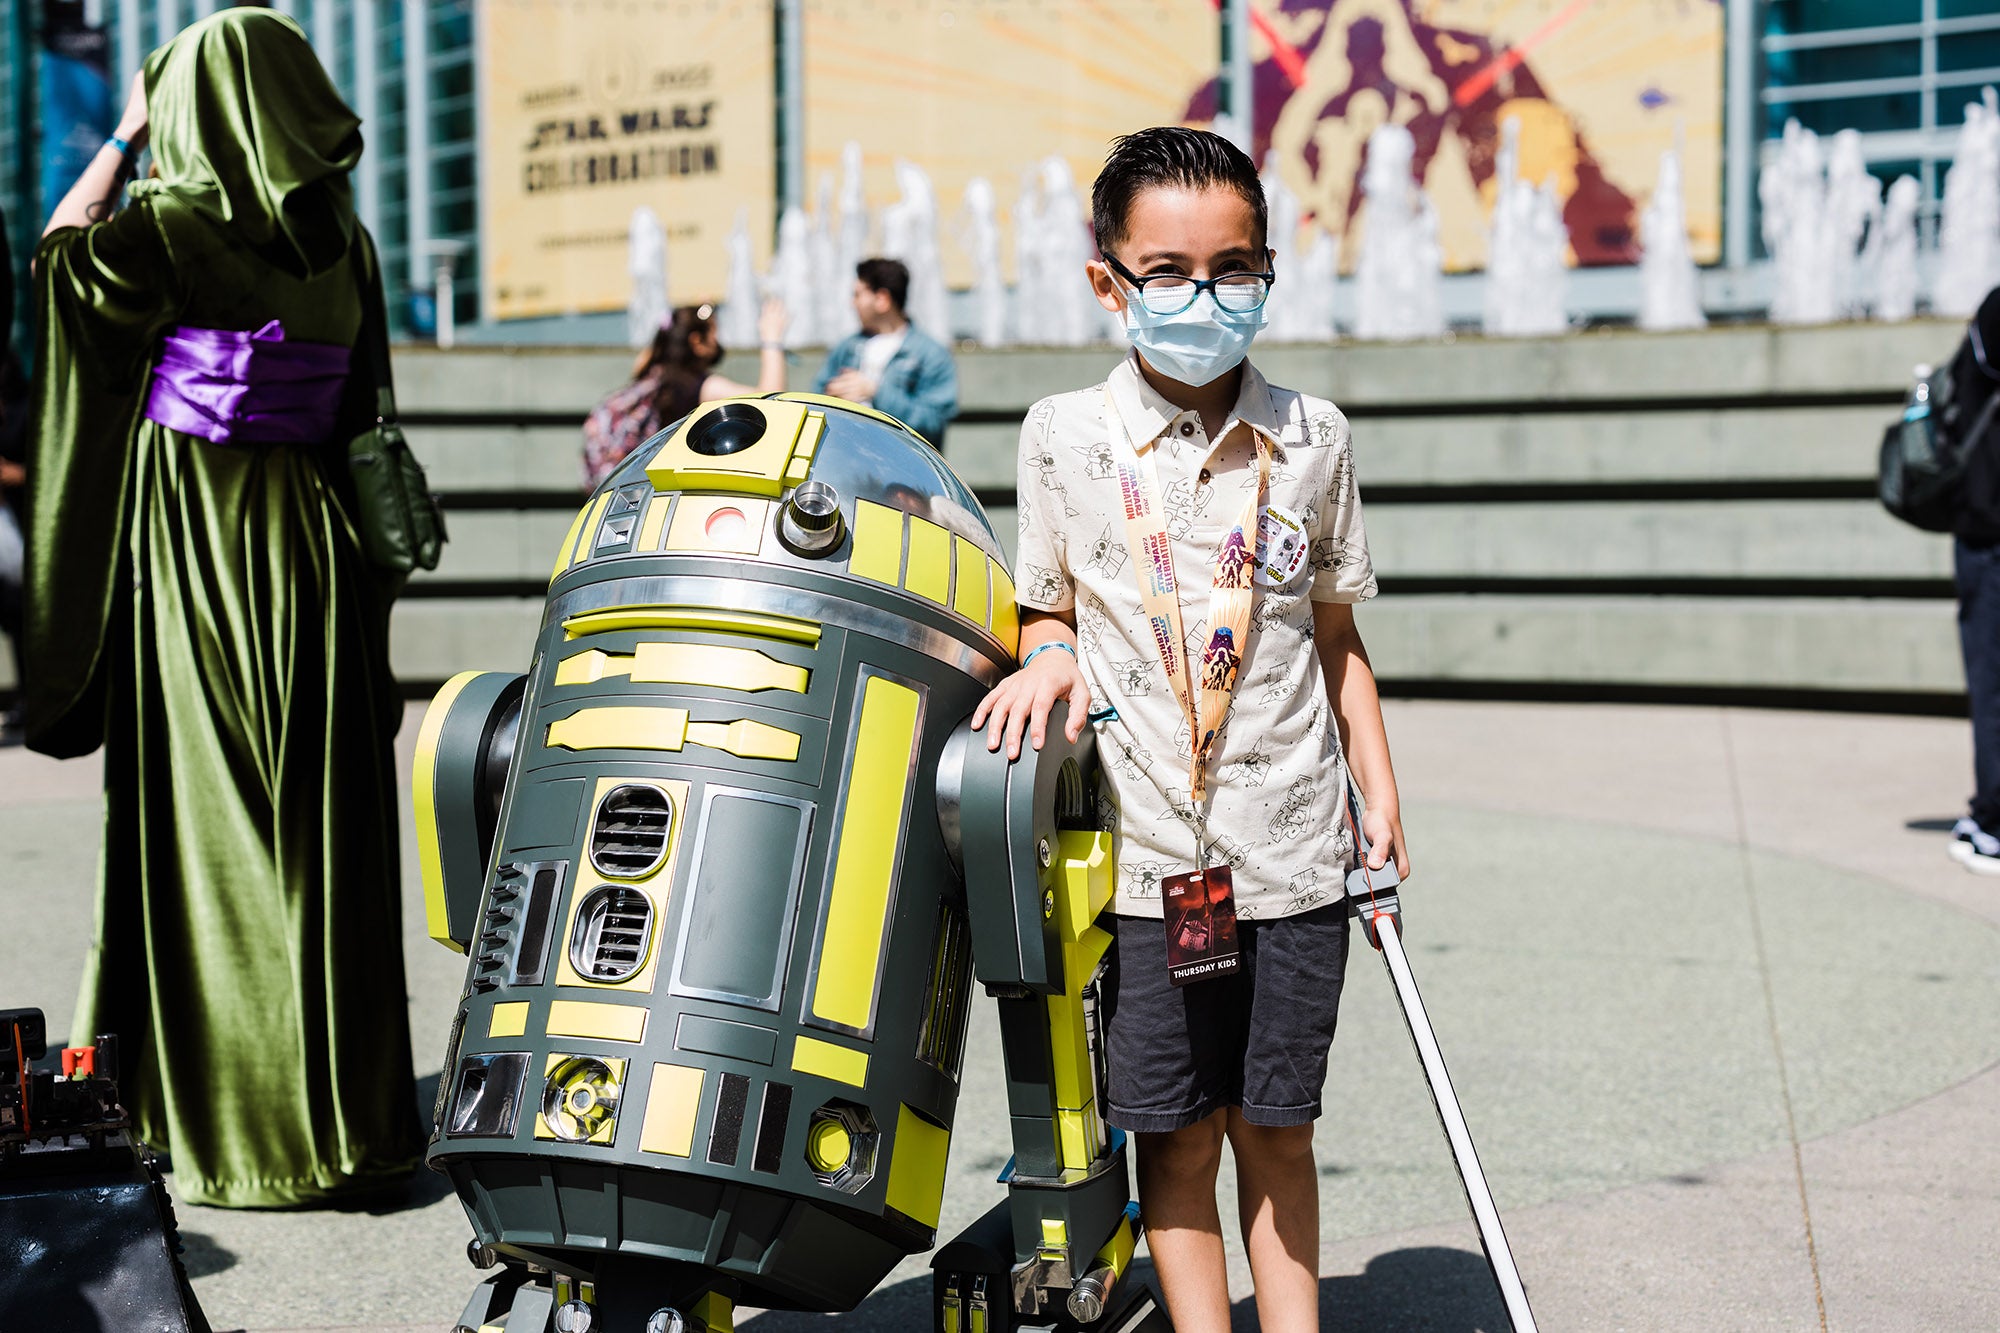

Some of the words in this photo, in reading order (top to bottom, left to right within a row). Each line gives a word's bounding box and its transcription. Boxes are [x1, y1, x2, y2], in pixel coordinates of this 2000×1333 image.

[1118, 463, 1135, 520] CELEBRATION
[1132, 489, 1143, 517] WARS
[1149, 534, 1161, 564] WARS
[1157, 531, 1174, 593] CELEBRATION
[1156, 563, 1166, 594] STAR
[1151, 616, 1172, 677] CELEBRATION
[1157, 616, 1170, 645] STAR
[1167, 645, 1176, 675] WARS
[1173, 963, 1216, 979] THURSDAY
[1218, 958, 1237, 970] KIDS
